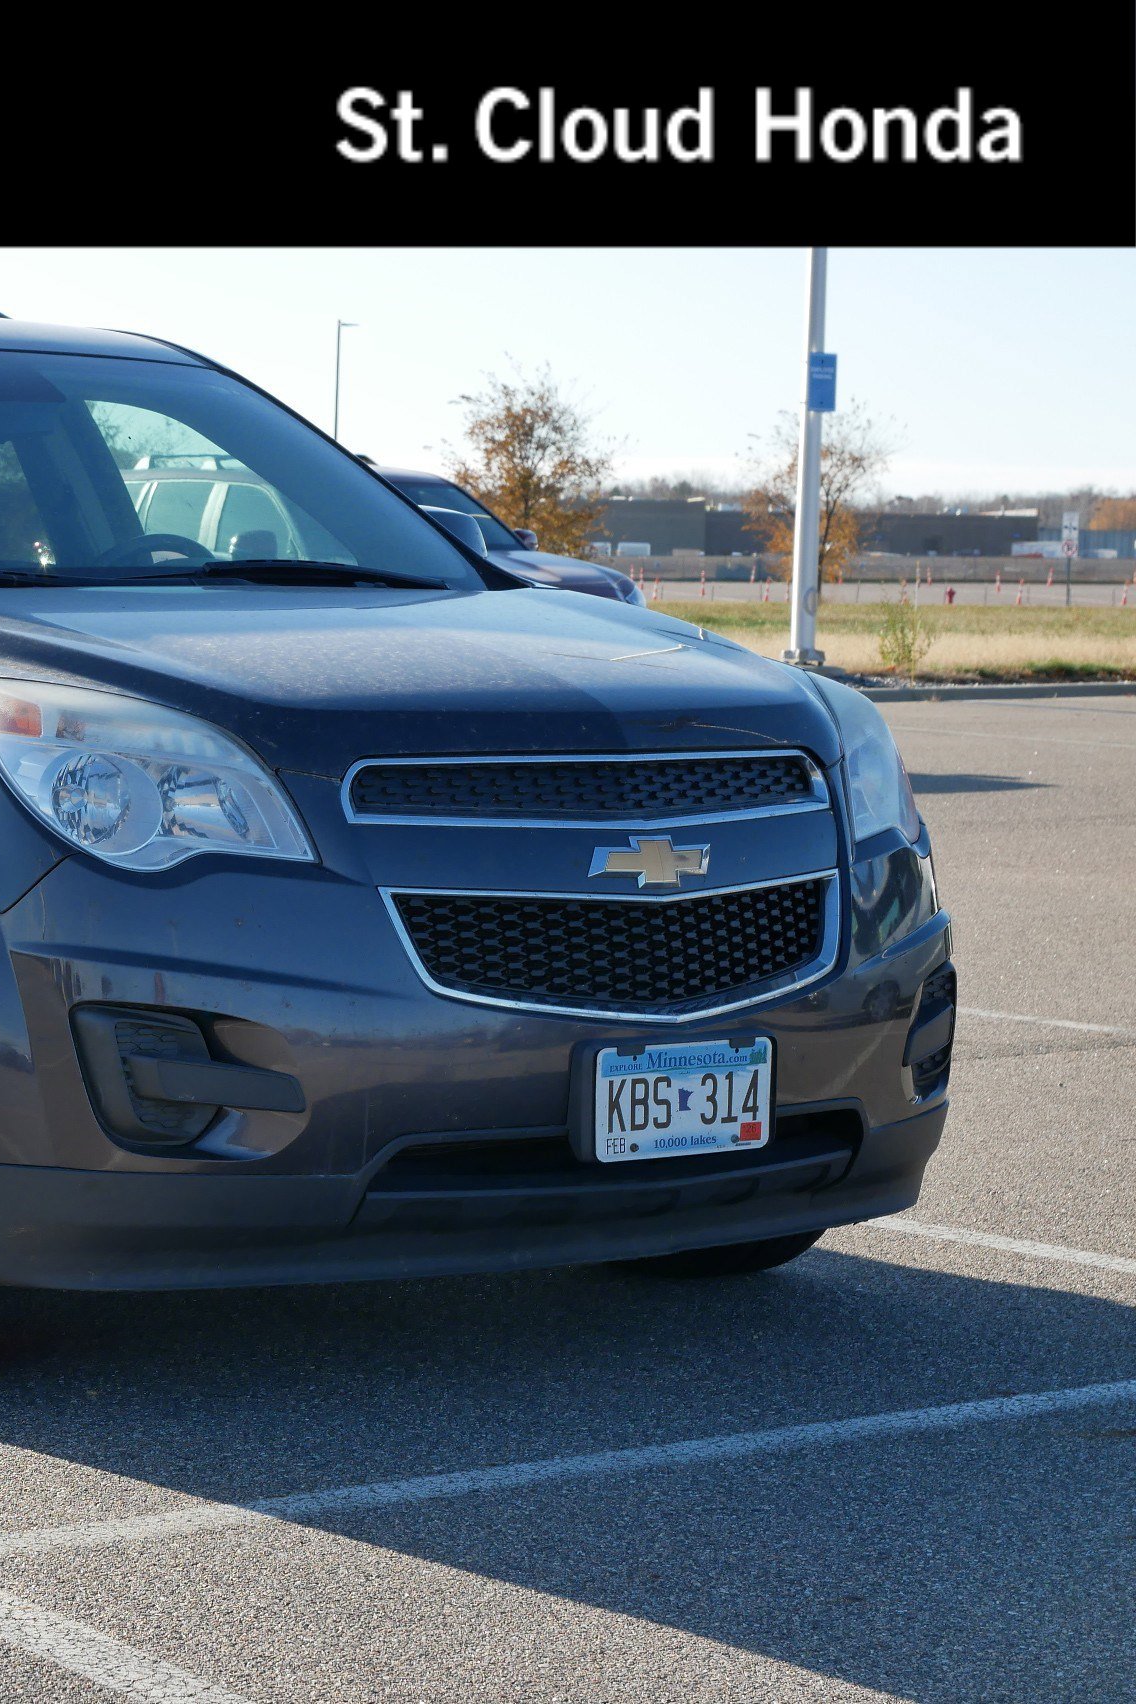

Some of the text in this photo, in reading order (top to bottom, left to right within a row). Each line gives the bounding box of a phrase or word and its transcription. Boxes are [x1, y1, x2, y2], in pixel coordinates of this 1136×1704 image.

[609, 1063, 643, 1073] EXPLORE
[607, 1069, 759, 1133] KBS 314
[606, 1137, 626, 1155] FEB
[654, 1136, 688, 1149] 10,000
[690, 1134, 717, 1146] lakes
